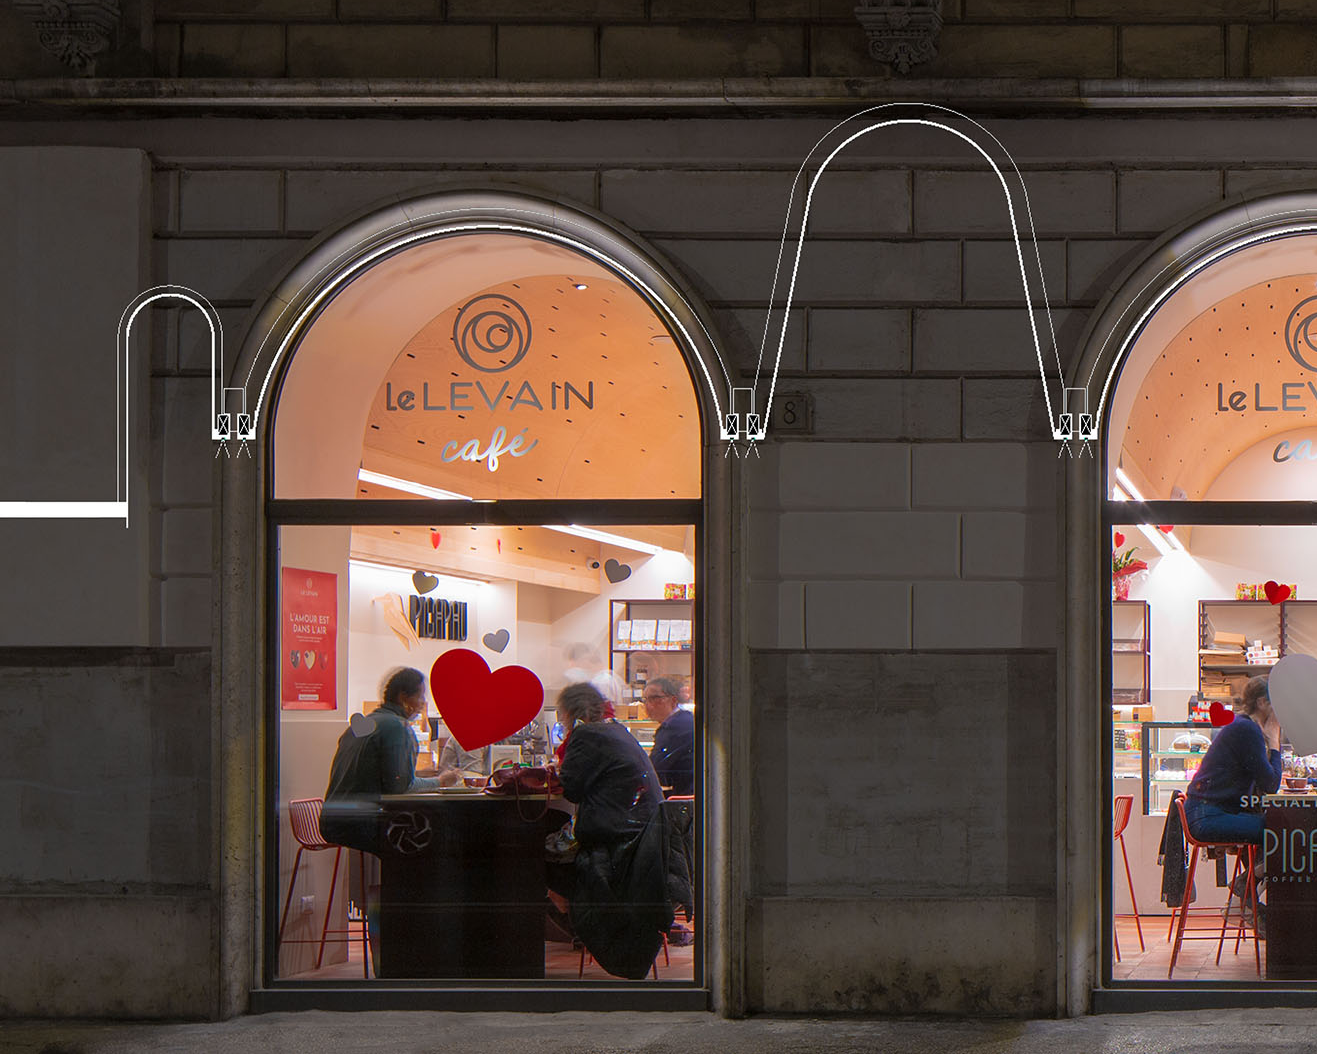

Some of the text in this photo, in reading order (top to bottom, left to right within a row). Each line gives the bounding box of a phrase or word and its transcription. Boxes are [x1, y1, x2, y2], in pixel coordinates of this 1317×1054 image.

[783, 401, 796, 424] 8
[441, 426, 538, 472] café
[289, 612, 329, 625] L'AMOUR EST
[293, 624, 311, 633] DANS
[409, 594, 468, 642] PICAPAU
